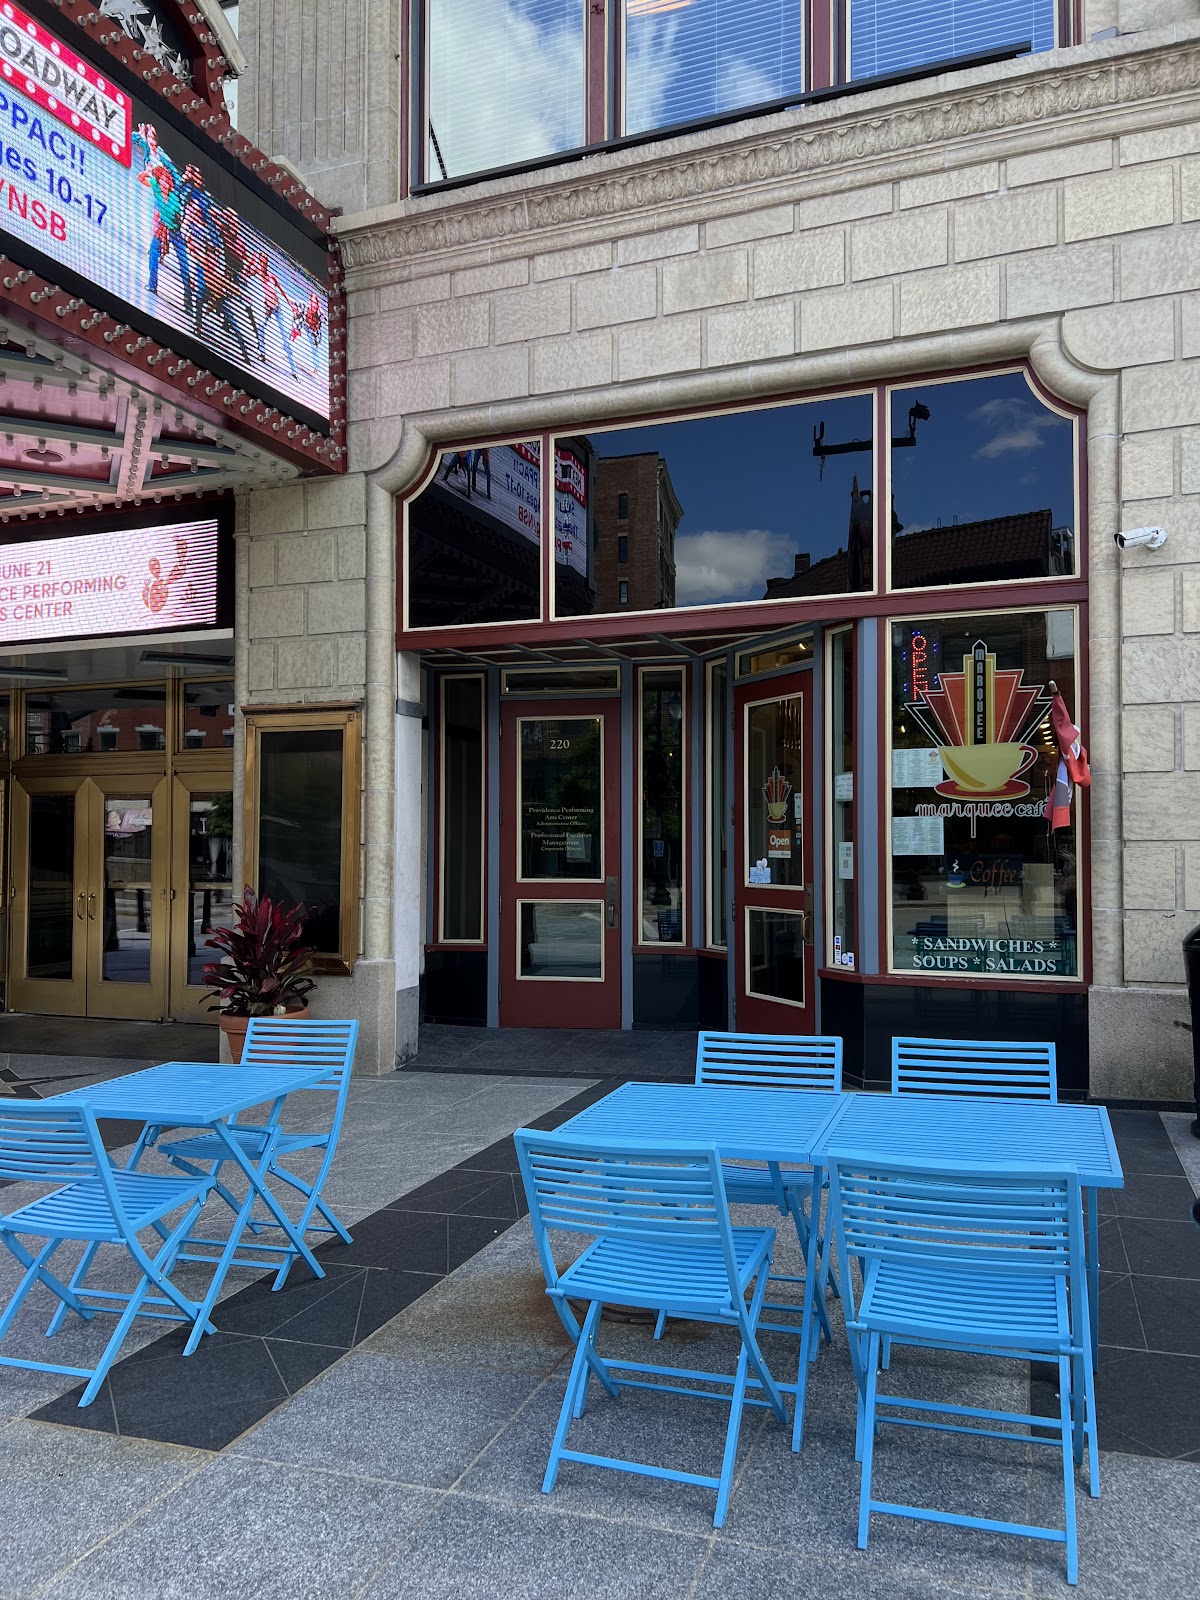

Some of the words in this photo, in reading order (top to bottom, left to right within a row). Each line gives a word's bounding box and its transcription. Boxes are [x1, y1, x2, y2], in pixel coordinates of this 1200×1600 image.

[0, 141, 36, 181] es
[46, 168, 108, 225] 10-17
[37, 560, 51, 576] 21
[23, 575, 127, 600] PERFORMING
[13, 601, 73, 620] CENTER
[912, 635, 928, 701] OPEN
[975, 649, 985, 739] MARQUEE
[549, 739, 570, 750] 220
[915, 802, 1014, 838] marquee
[769, 834, 790, 848] Open
[970, 858, 1017, 891] Coffee
[923, 937, 1044, 954] SANDWICHES
[912, 955, 969, 970] SOUPS
[985, 957, 1057, 973] SALADS
